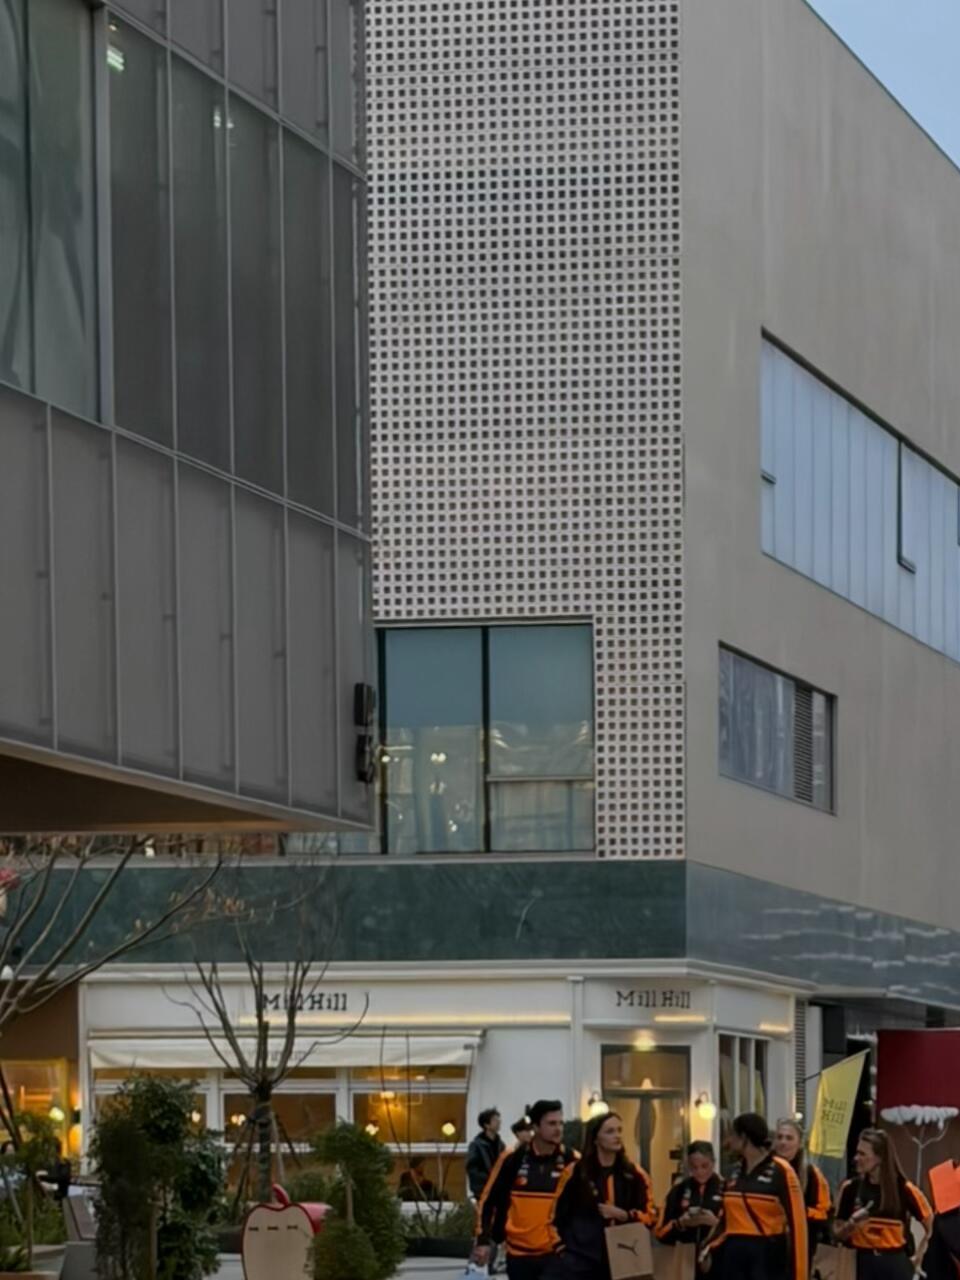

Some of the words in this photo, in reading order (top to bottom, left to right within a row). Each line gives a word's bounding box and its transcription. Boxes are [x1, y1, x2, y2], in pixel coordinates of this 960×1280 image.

[309, 993, 347, 1010] Hill
[616, 990, 657, 1007] Mill
[661, 989, 690, 1008] Hill
